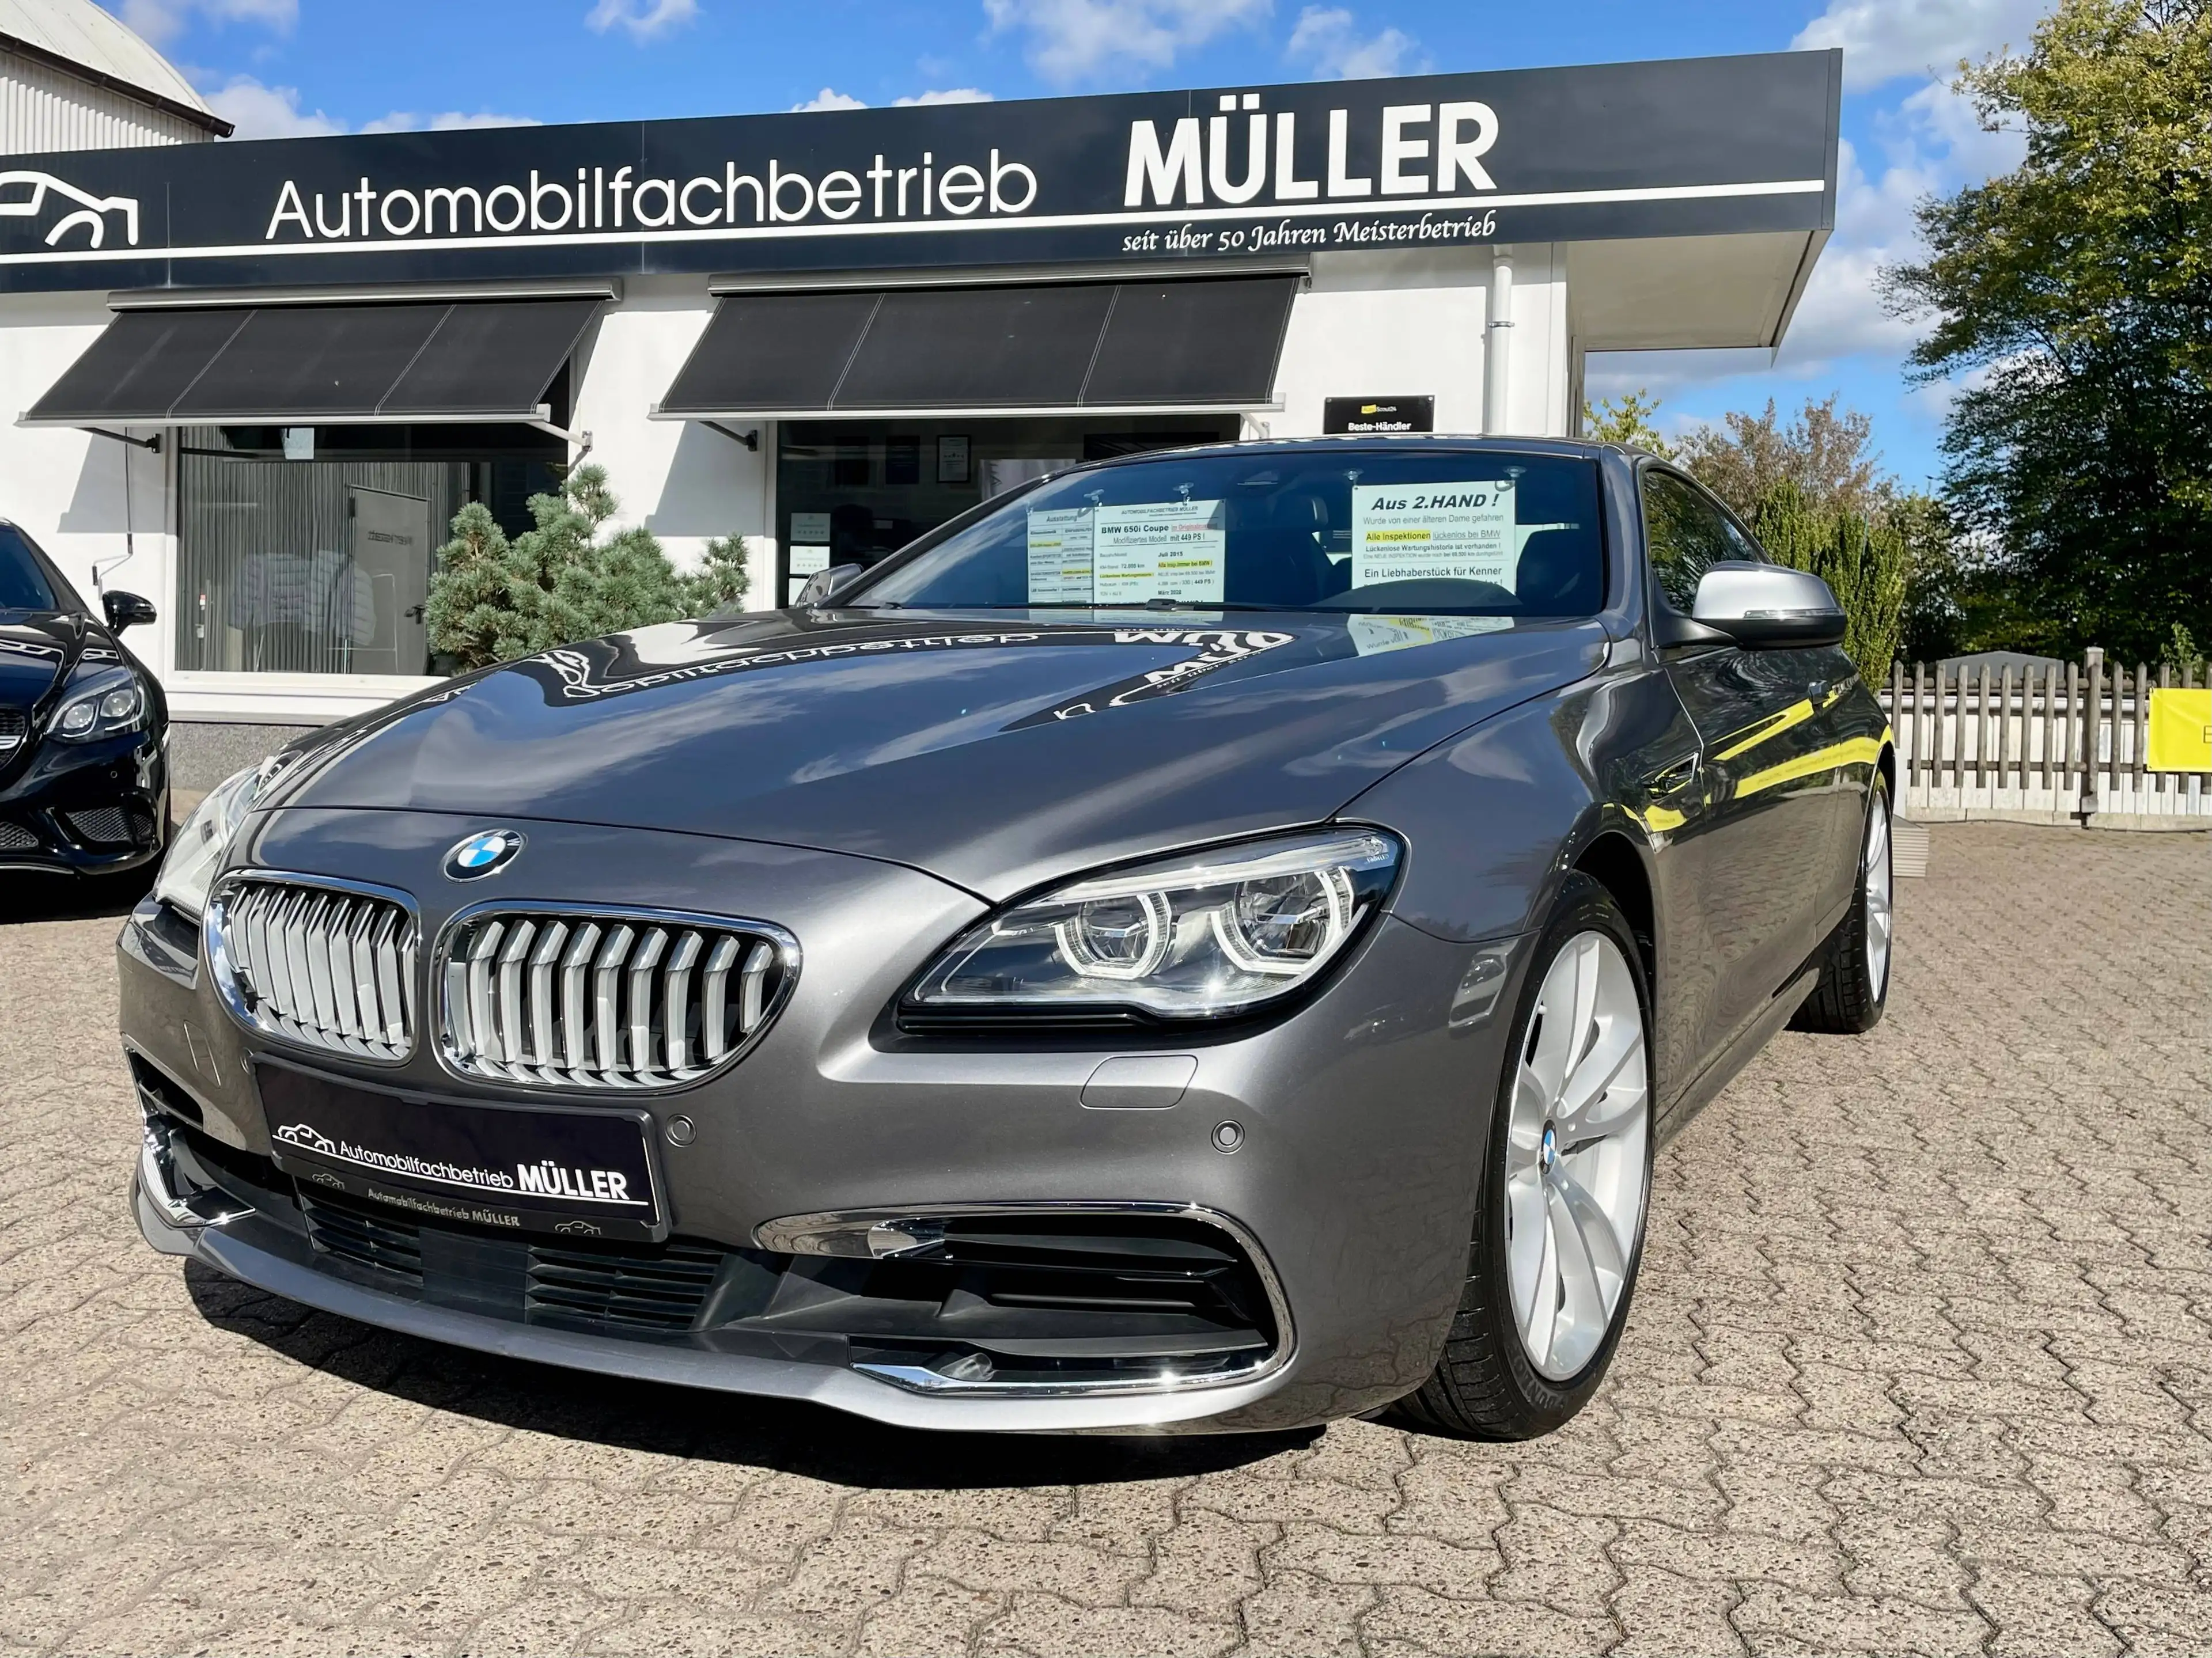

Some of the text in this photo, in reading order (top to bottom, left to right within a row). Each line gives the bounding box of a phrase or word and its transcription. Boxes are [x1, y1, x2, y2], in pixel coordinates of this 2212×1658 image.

[265, 93, 1499, 240] Automobilfachbetrieb MÜLLER
[1122, 209, 1497, 252] seit über 50 Jahren Meisterbetrieb
[1347, 422, 1411, 432] Beste-Händler
[1371, 494, 1499, 511] Aus 2.HAND !
[1363, 517, 1386, 525] Wurde
[1403, 515, 1421, 524] einer
[1422, 514, 1447, 523] älteren
[1448, 514, 1470, 523] Dame
[1472, 513, 1503, 524] gefahren
[1101, 525, 1121, 534] BMW
[1123, 525, 1141, 533] 650i
[1143, 524, 1169, 533] Coupe
[1149, 534, 1167, 542] Modell
[1170, 534, 1180, 542] mit
[1193, 532, 1202, 541] PS
[1366, 529, 1500, 542] Alle Inspektionen lückenlos bei BMW
[1402, 543, 1453, 553] Wartungshistorie
[1464, 542, 1497, 550] vorhanden
[1365, 566, 1502, 578] Ein Liebhaberstück für Kenner
[339, 1140, 630, 1201] Automobilfachbetrieb MÜLLER
[368, 1187, 520, 1227] Automobilfachbetrieb MÜLLER
